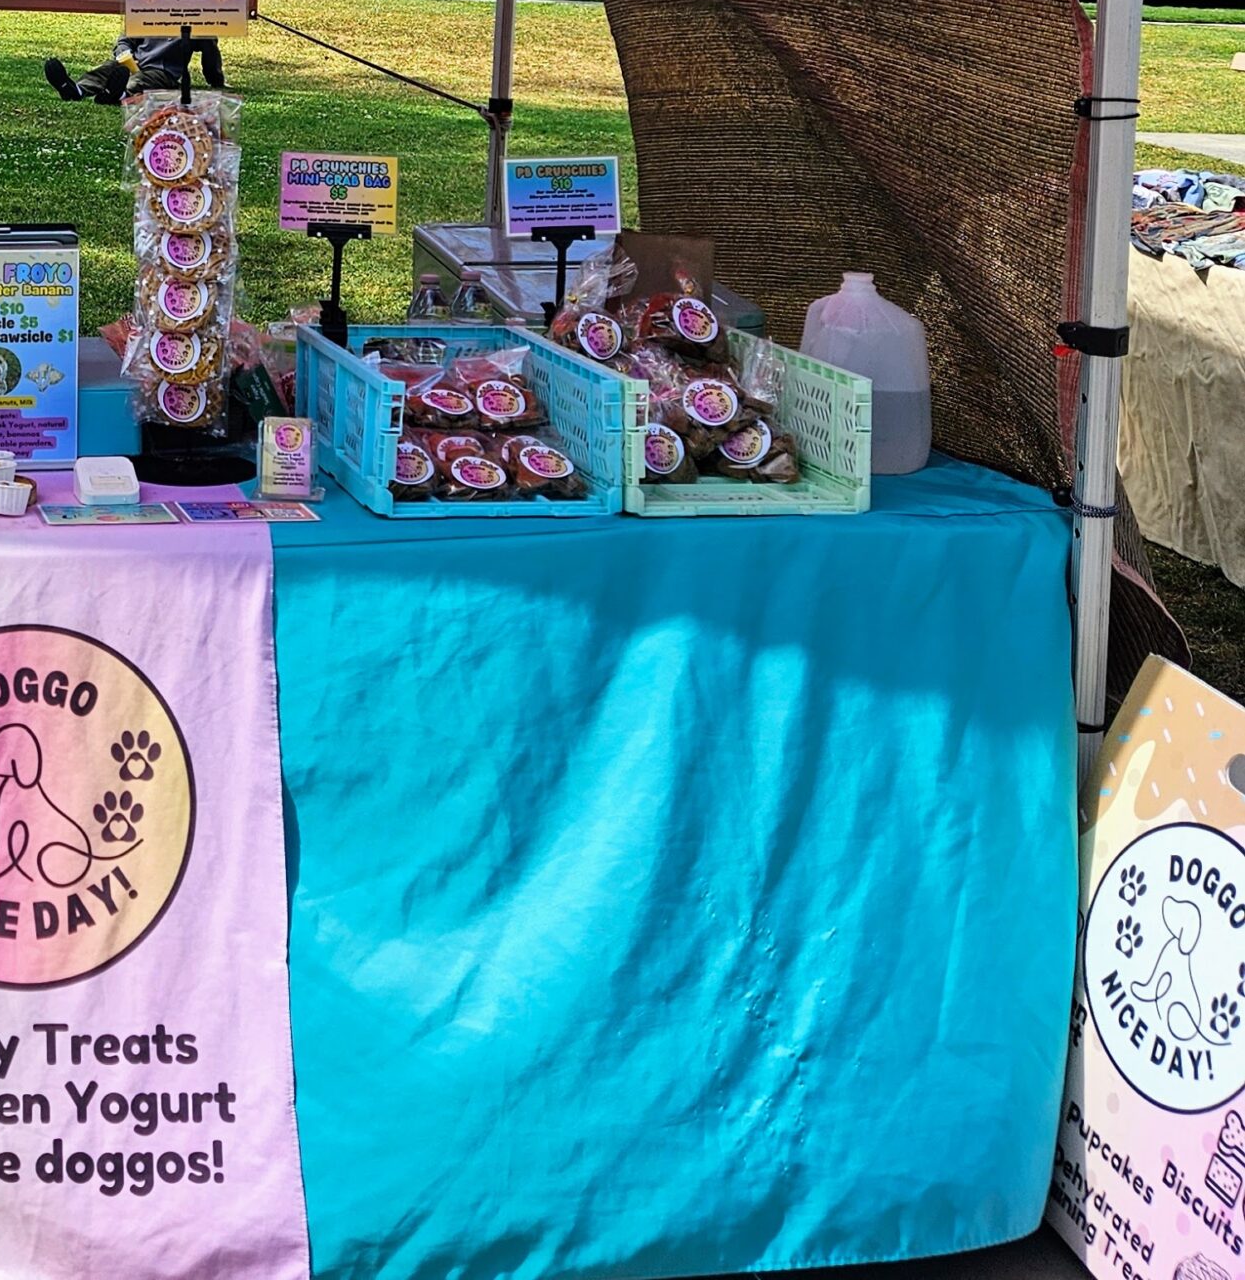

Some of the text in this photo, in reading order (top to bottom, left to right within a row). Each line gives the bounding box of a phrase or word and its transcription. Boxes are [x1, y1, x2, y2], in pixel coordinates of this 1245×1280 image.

[291, 158, 388, 176] PB CRUNCHIES
[516, 163, 607, 178] PB CRUNCHIES
[287, 171, 391, 188] MINI-GRAB BAG
[551, 177, 572, 190] $10
[330, 185, 348, 200] $5
[3, 262, 73, 284] FROYO
[22, 284, 74, 297] Banana
[0, 301, 24, 315] $10
[20, 315, 38, 329] $5
[58, 329, 73, 342] $1
[34, 866, 139, 940] DAY!
[1100, 970, 1148, 1049] NICE
[1150, 1035, 1215, 1081] DAY!
[33, 1023, 199, 1066] Treats
[66, 1080, 236, 1136] Yogurt
[1066, 1101, 1155, 1206] Pupcakes
[35, 1140, 224, 1196] doggos!
[1161, 1160, 1244, 1256] Biscuits
